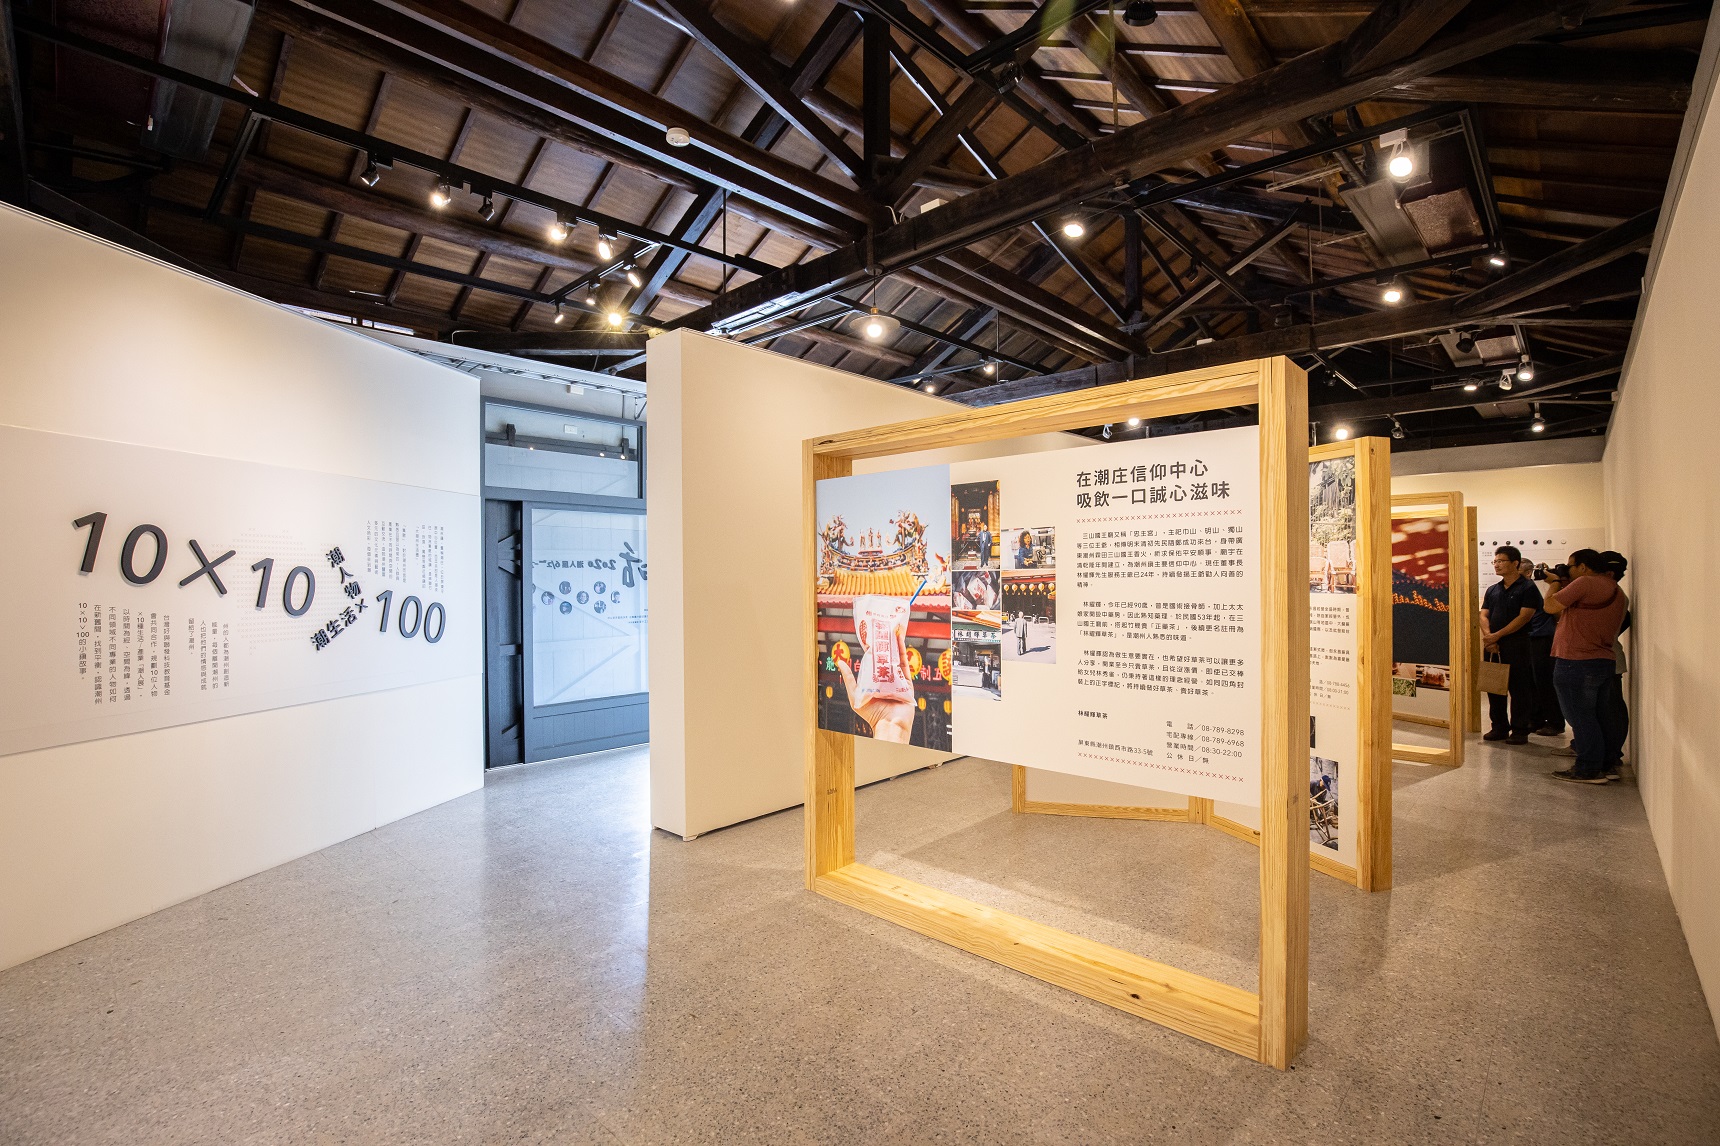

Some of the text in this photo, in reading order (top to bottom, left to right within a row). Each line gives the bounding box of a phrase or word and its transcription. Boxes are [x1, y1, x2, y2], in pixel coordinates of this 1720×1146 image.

[1076, 459, 1208, 488] 在潮庄信仰中心
[1076, 481, 1231, 509] 吸飲一口誠心滋味
[326, 547, 362, 599] 潮人物
[310, 606, 357, 651] 潮生活
[376, 590, 446, 643] 100
